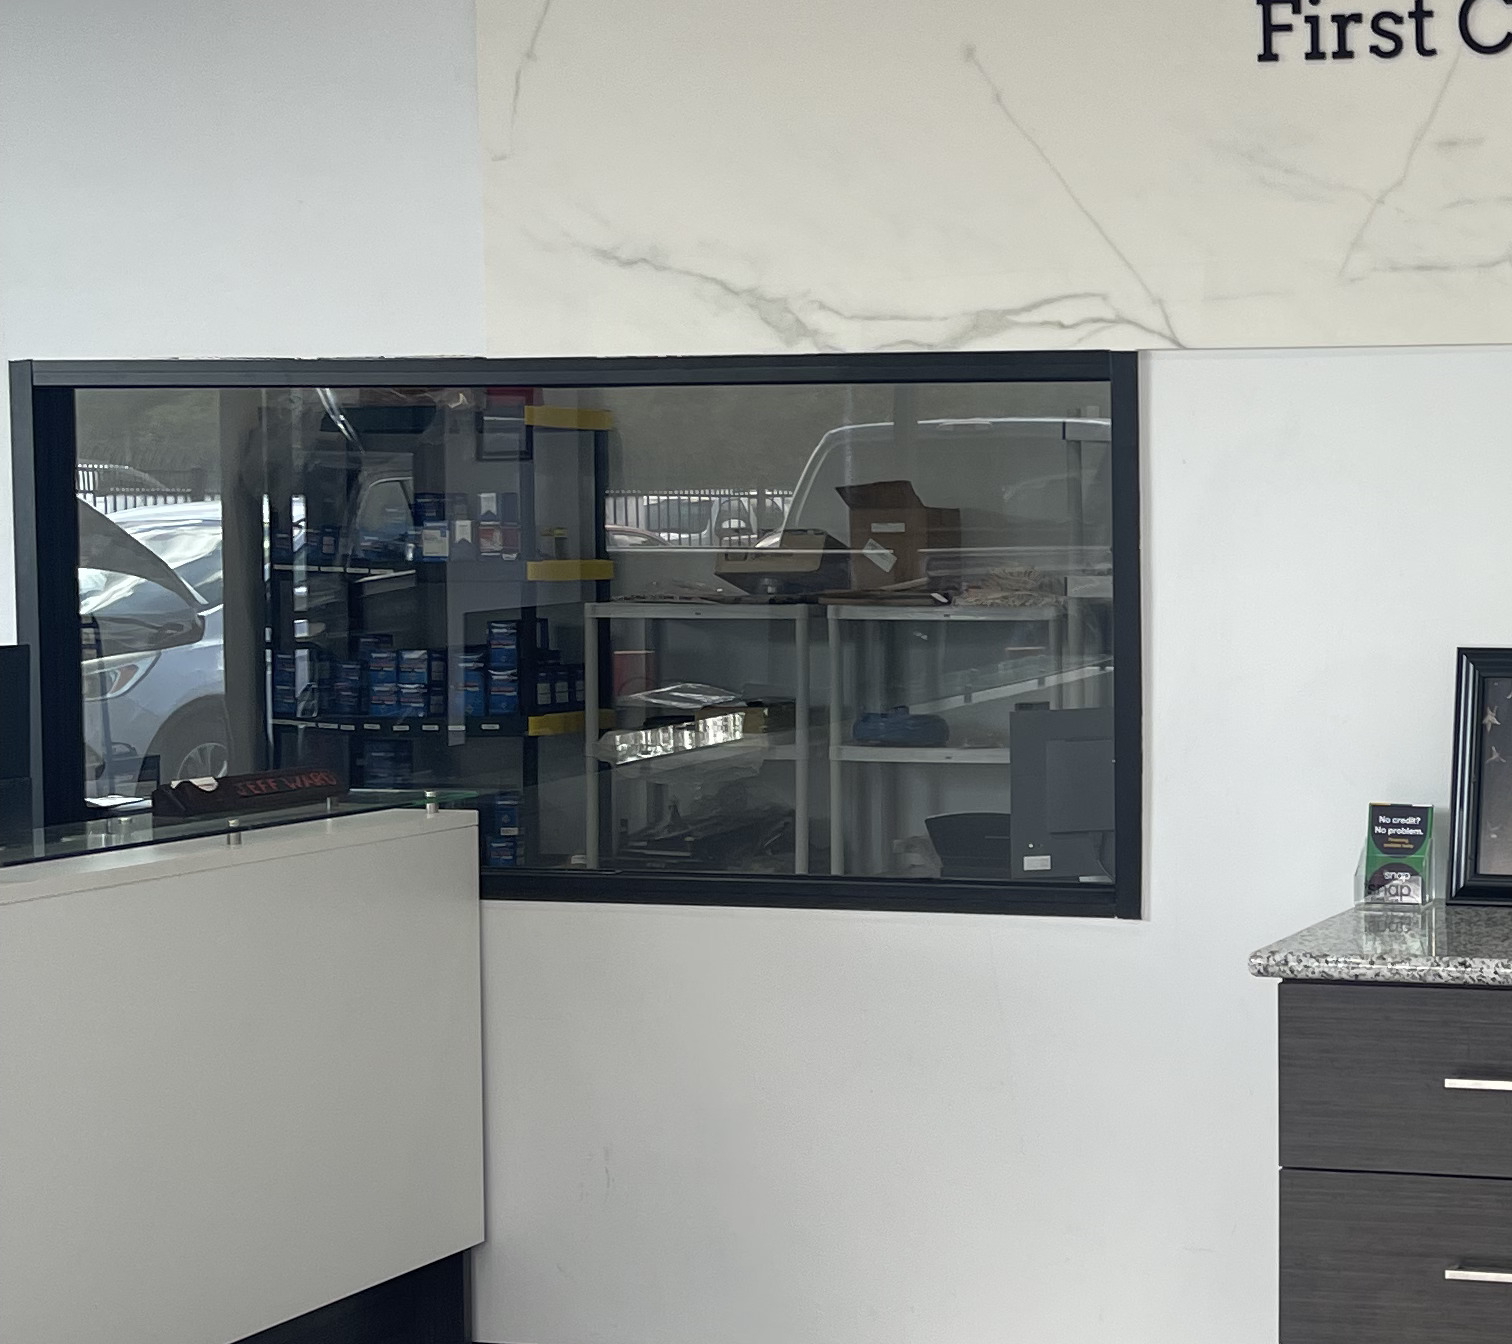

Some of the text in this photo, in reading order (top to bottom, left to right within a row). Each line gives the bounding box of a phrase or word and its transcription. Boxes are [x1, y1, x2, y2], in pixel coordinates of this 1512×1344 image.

[236, 777, 278, 796] JEFF
[1378, 815, 1421, 825] No credit?
[1374, 826, 1387, 834] No
[1383, 871, 1411, 882] snap
